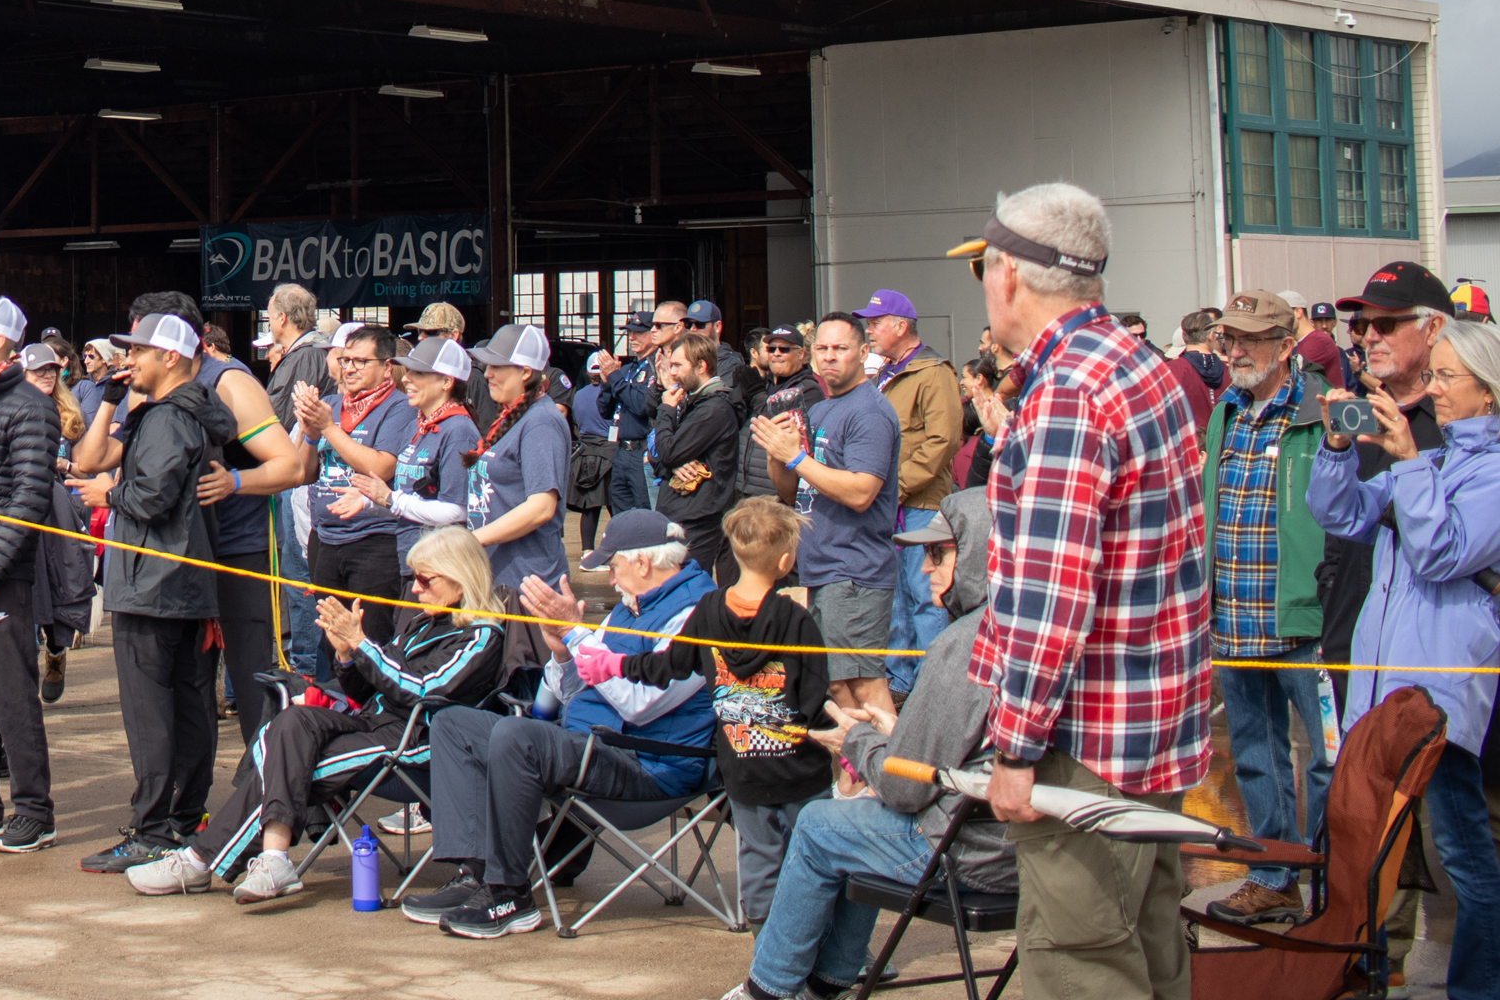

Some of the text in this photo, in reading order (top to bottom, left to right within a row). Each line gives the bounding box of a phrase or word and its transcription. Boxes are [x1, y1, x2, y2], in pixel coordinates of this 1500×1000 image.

[374, 282, 417, 298] Driving
[420, 281, 437, 295] for
[488, 901, 517, 920] HOKA
